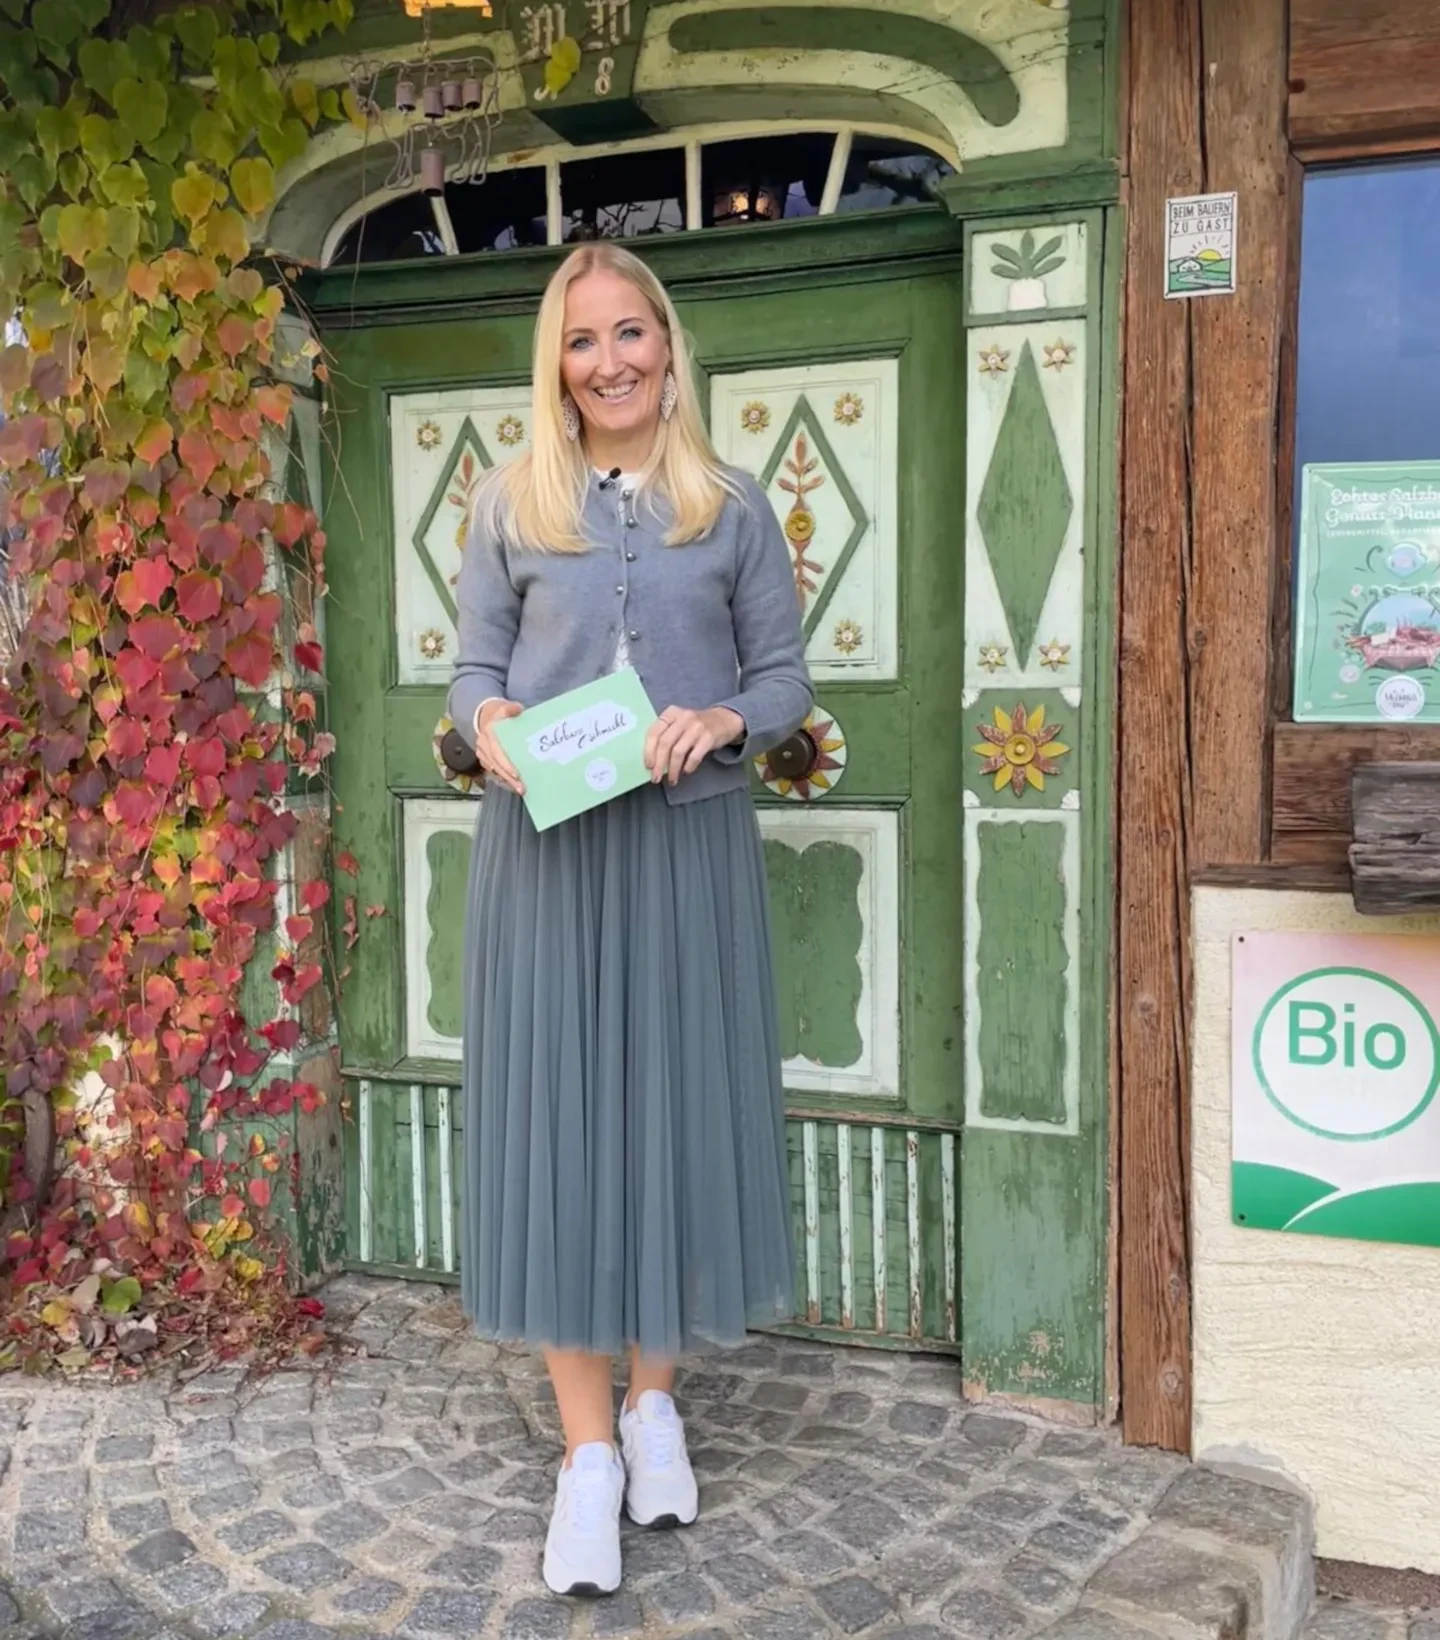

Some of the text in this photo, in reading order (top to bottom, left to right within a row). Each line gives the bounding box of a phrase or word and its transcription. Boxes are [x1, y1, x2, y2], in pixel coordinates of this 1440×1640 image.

[1173, 201, 1231, 219] BEIM BAUERN
[1173, 217, 1228, 234] ZU GAST
[1288, 1000, 1407, 1070] Bio
